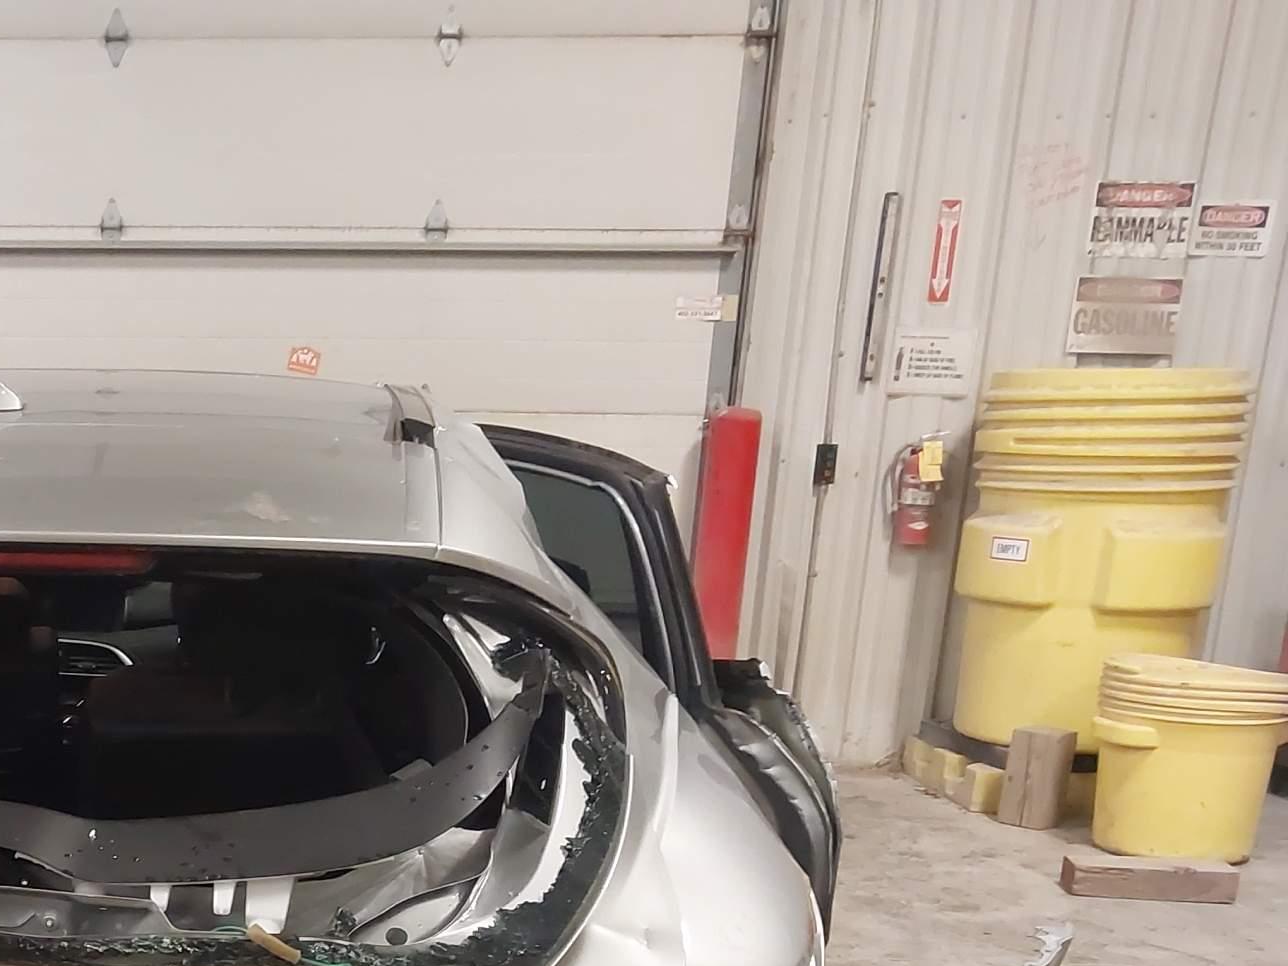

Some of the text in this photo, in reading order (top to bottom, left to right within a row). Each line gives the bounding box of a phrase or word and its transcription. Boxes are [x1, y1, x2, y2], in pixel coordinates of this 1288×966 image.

[1204, 210, 1264, 225] DANGER
[1202, 230, 1258, 240] NO SMOKING
[1239, 242, 1263, 252] FEET
[1073, 307, 1178, 336] GASOLINE
[997, 543, 1021, 555] EMPTY
